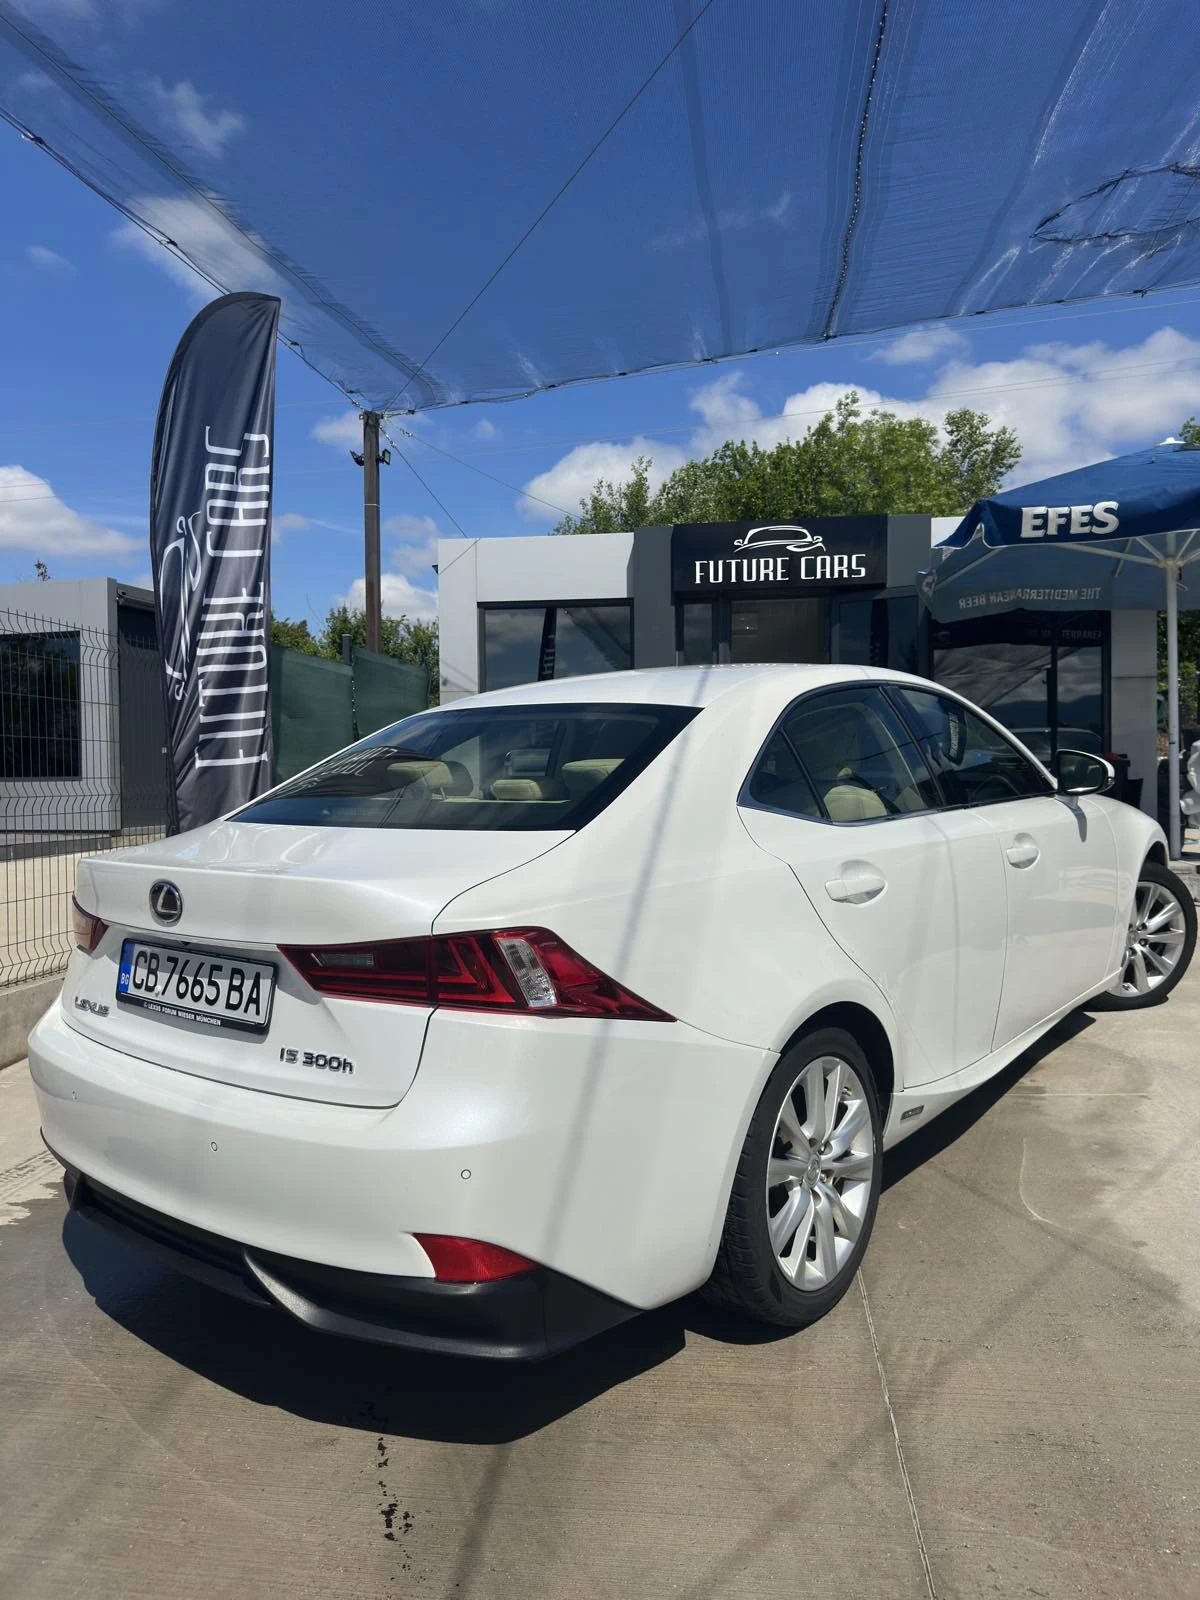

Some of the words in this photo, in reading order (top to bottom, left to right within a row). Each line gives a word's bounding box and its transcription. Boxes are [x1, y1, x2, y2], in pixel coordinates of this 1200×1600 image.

[204, 426, 271, 559] CARS
[1020, 501, 1120, 538] EFES
[694, 557, 790, 584] FUTURE
[800, 554, 866, 580] CARS
[193, 581, 269, 769] FUTURE
[120, 972, 130, 985] BG
[280, 1047, 299, 1064] IS
[302, 1051, 355, 1075] 300h
